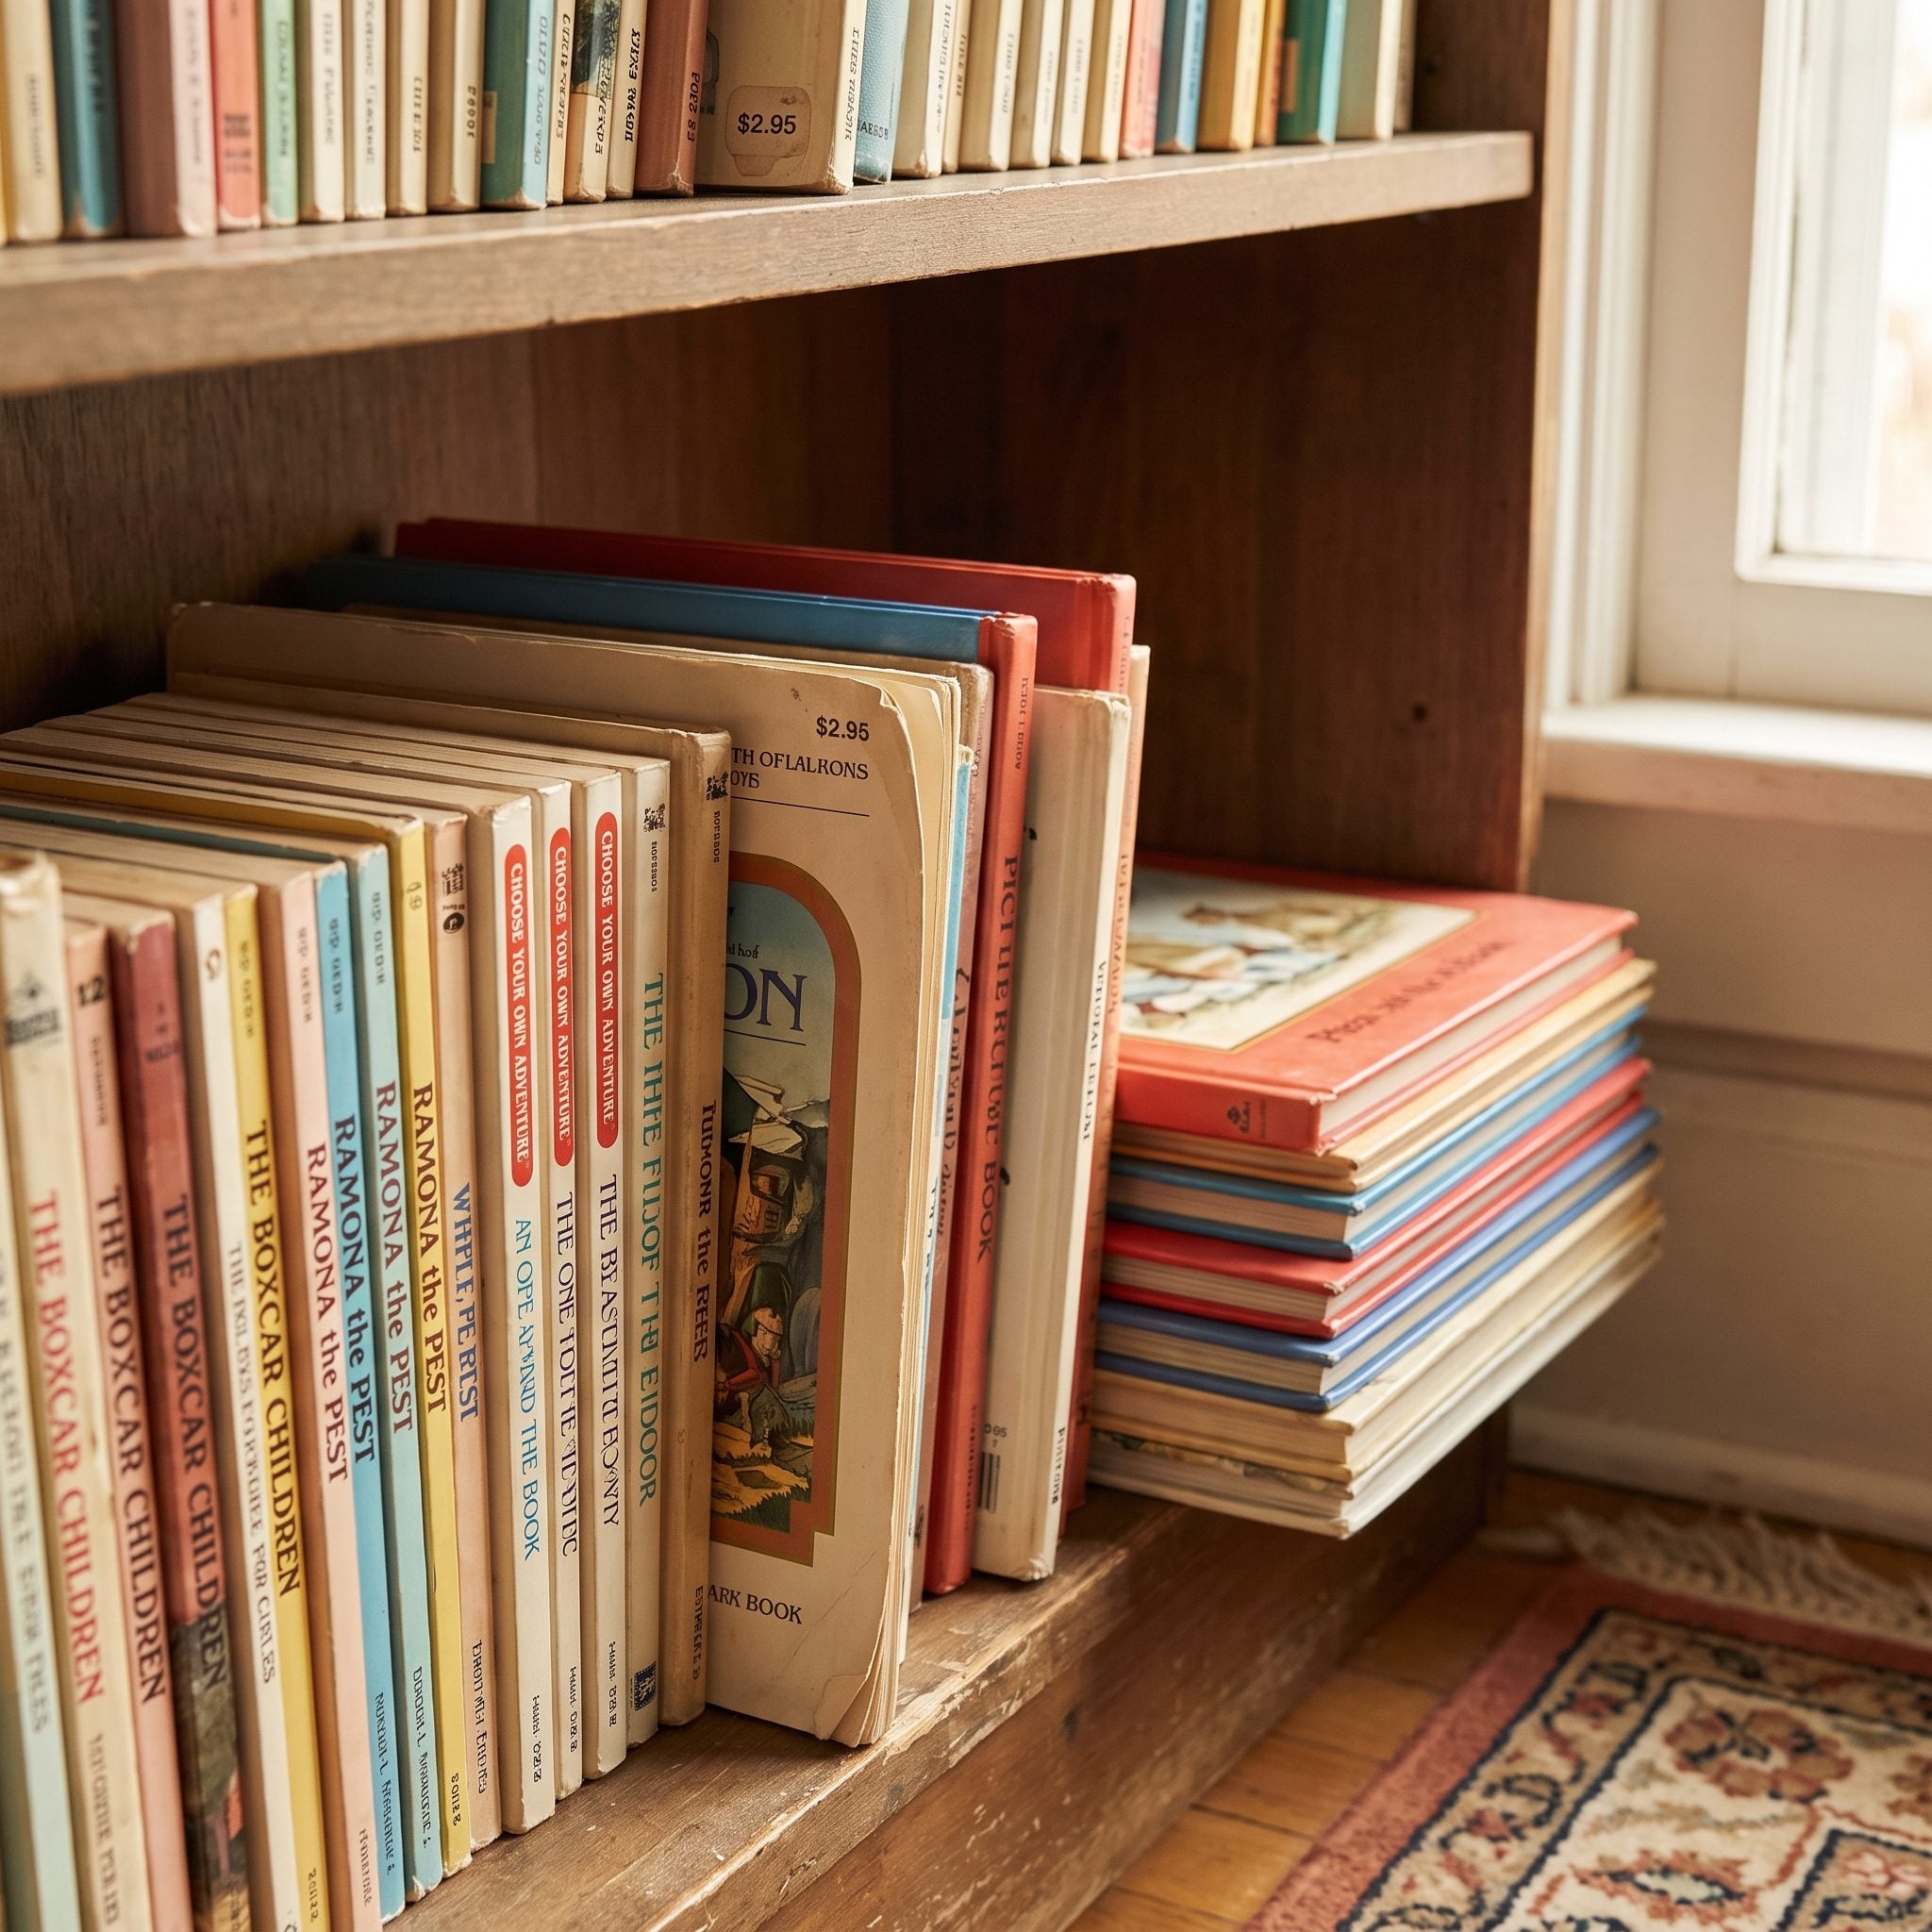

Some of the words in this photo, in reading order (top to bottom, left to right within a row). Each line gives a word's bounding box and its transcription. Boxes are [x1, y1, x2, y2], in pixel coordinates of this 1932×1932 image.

[737, 112, 797, 136] $2.95
[815, 714, 870, 741] $2.95
[510, 862, 525, 943] CHOOSE
[555, 846, 567, 925] CHOOSE
[601, 830, 613, 908] CHOOSE
[512, 947, 525, 1001] YOUR
[556, 929, 568, 980] YOUR
[601, 913, 613, 966] YOUR
[513, 1005, 526, 1049] OWN
[557, 985, 568, 1028] OWN
[602, 970, 613, 1012] OWN
[643, 972, 664, 1050] THE
[514, 1056, 529, 1163] ADVENTURE
[558, 1035, 570, 1141] ADVENTURE
[602, 1019, 614, 1124] ADVENTURE
[246, 1119, 273, 1206] THE
[376, 1081, 404, 1270] RAMONA
[413, 1081, 440, 1257] RAMONA
[31, 1191, 64, 1287] THE
[97, 1184, 127, 1279] THE
[164, 1196, 192, 1288] THE
[308, 1141, 335, 1320] RAMONA
[335, 1113, 364, 1301] RAMONA
[515, 1220, 532, 1255] AN
[557, 1191, 574, 1256] THE
[599, 1174, 618, 1241] THE
[977, 1160, 997, 1264] BOOK
[697, 1225, 711, 1276] the
[253, 1214, 285, 1387] BOXCAR
[387, 1280, 408, 1340] the
[422, 1265, 442, 1323] the
[558, 1262, 575, 1324] ONE
[320, 1330, 341, 1389] the
[346, 1307, 369, 1369] the
[425, 1328, 446, 1414] PEST
[40, 1295, 80, 1476] BOXCAR
[107, 1287, 144, 1476] BOXCAR
[173, 1298, 208, 1476] BOXCAR
[350, 1374, 375, 1464] PEST
[390, 1346, 413, 1434] PEST
[325, 1395, 348, 1482] PEST
[521, 1418, 538, 1475] THE
[266, 1397, 301, 1596] CHILDREN
[523, 1480, 540, 1561] BOOK
[58, 1490, 104, 1705] CHILDREN
[125, 1489, 166, 1704] CHILDREN
[190, 1484, 227, 1691] CHILDREN
[708, 1584, 741, 1607] ARK
[746, 1593, 802, 1624] BOOK
